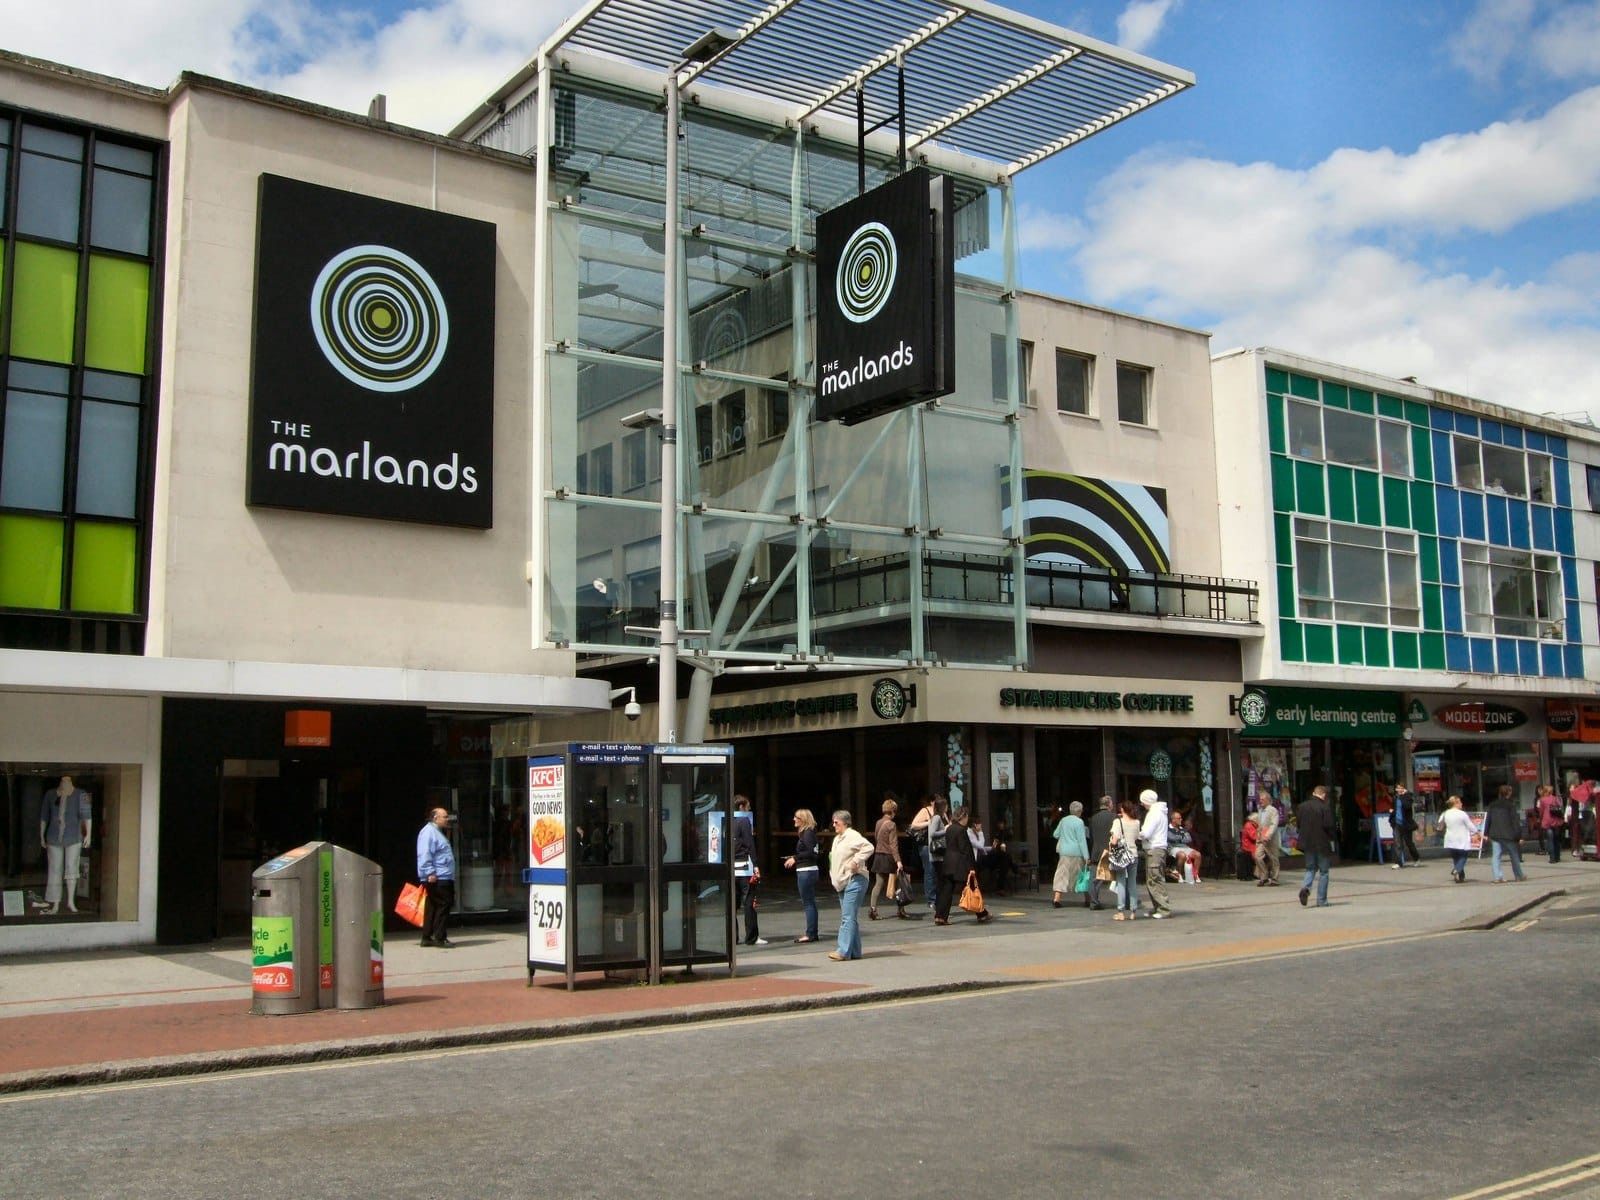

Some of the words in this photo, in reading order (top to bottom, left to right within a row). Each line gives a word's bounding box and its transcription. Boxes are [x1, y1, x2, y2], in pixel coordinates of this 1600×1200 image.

[822, 360, 839, 374] THE
[822, 340, 914, 396] marlands
[270, 420, 312, 438] THE
[269, 441, 478, 493] marlands
[1000, 688, 1121, 710] STARBUCKS
[1123, 693, 1194, 713] COFFEE
[1276, 704, 1306, 726] early
[1310, 705, 1358, 727] learning
[1361, 708, 1397, 723] centre
[1445, 711, 1514, 724] MODELZONE
[532, 770, 553, 785] KFC
[533, 802, 547, 815] GOOD
[547, 801, 563, 815] NEWS!
[323, 895, 333, 927] recycle
[534, 900, 562, 929] £2.99
